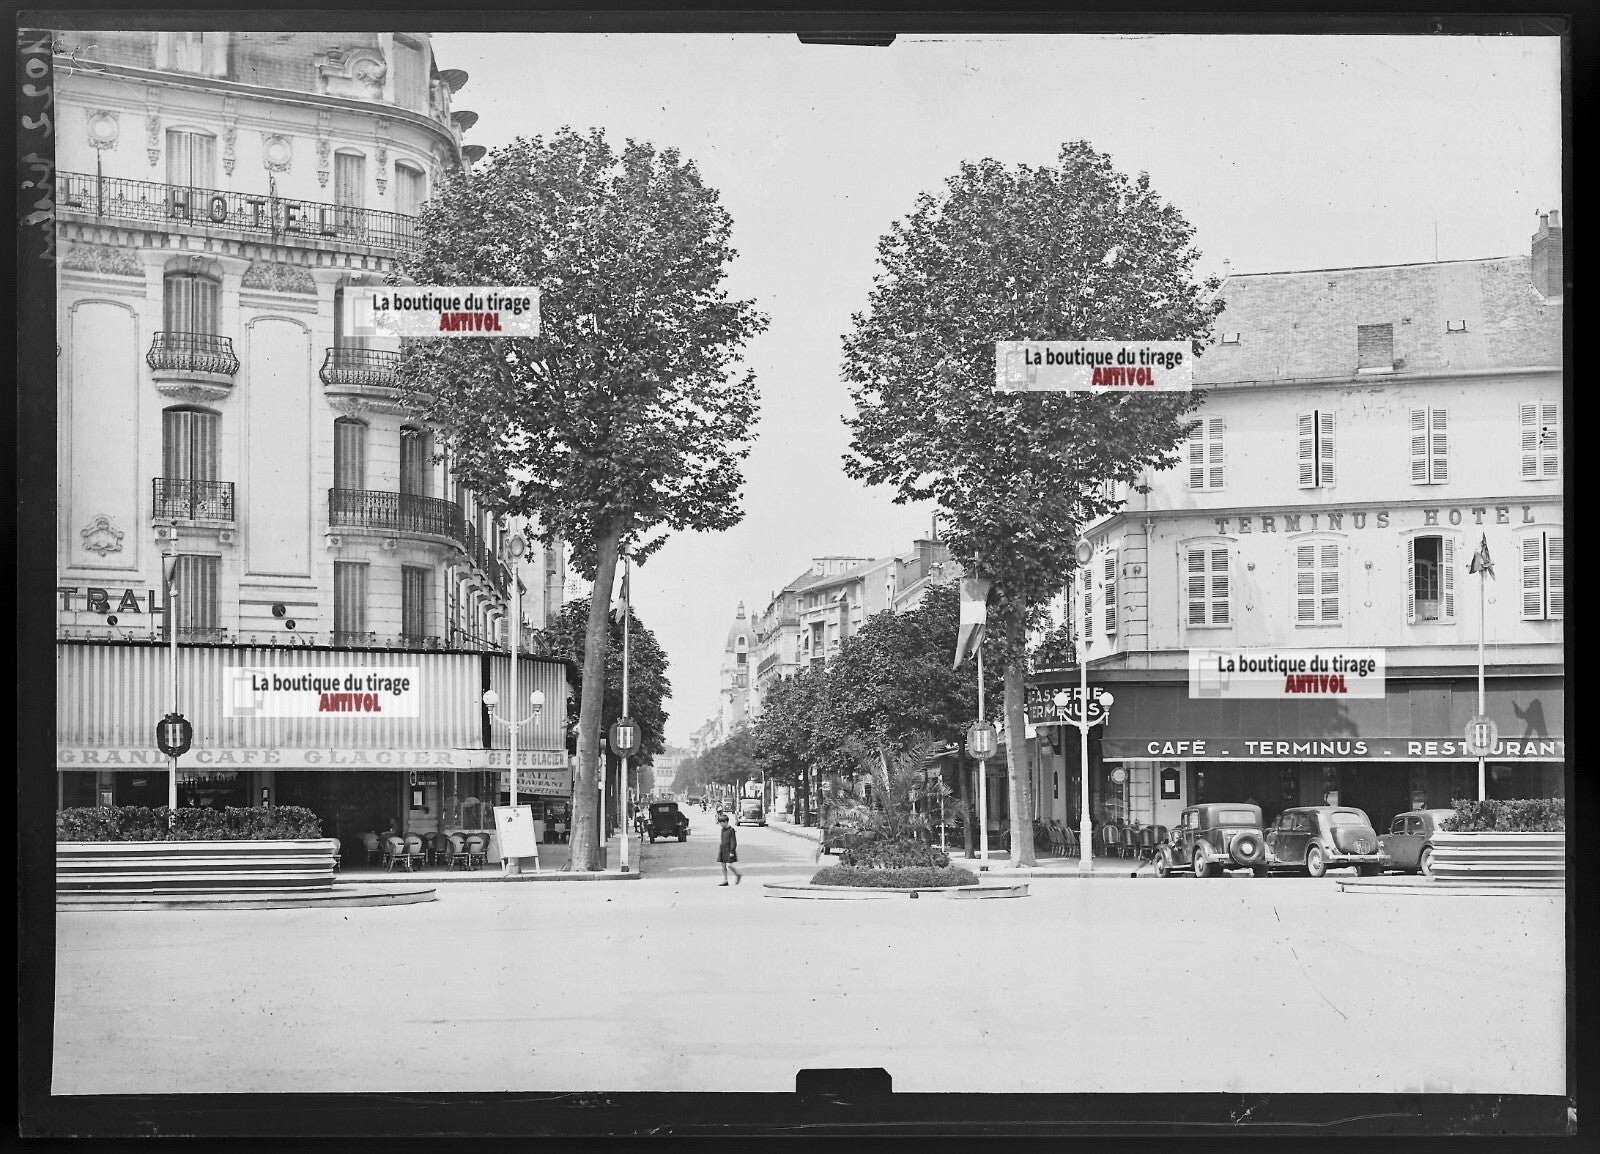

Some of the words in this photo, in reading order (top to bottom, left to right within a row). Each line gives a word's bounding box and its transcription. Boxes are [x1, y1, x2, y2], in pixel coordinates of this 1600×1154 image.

[167, 189, 337, 237] HOTEL
[1215, 511, 1390, 535] TERMINUS
[1424, 505, 1535, 527] HOTEL
[57, 587, 166, 614] TRAL
[57, 750, 171, 764] GRAND
[304, 750, 453, 765] GLACIER
[1147, 739, 1206, 755] CAFÉ
[1244, 740, 1368, 756] TERMINUS
[531, 753, 564, 766] GLACIER
